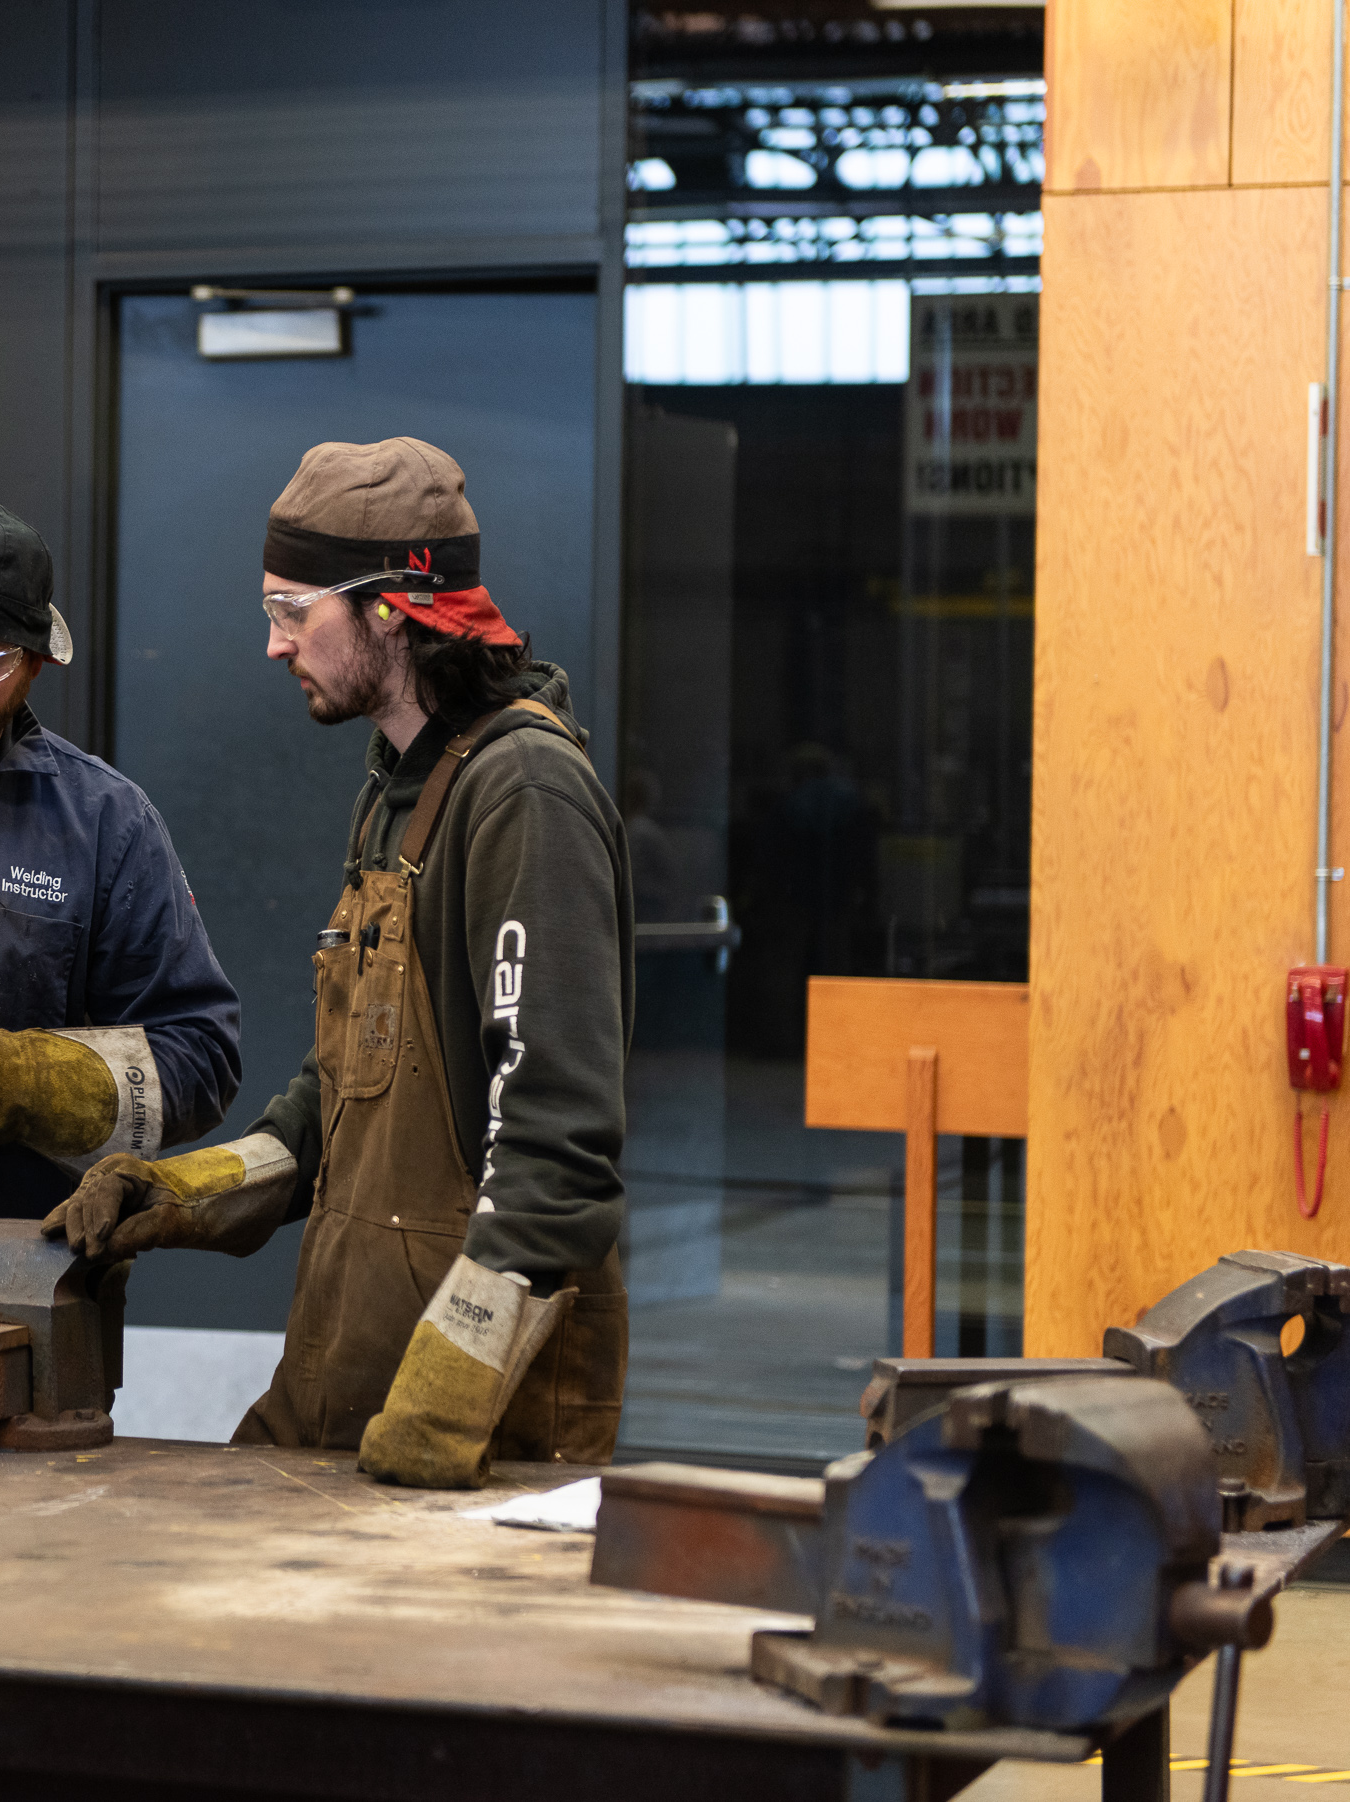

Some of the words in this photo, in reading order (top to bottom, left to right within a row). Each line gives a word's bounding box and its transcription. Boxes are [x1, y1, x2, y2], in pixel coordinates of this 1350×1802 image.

[1, 878, 69, 903] Instructor
[11, 865, 62, 890] Welding
[130, 1086, 146, 1150] PLATINUM
[450, 1293, 494, 1322] WATSON
